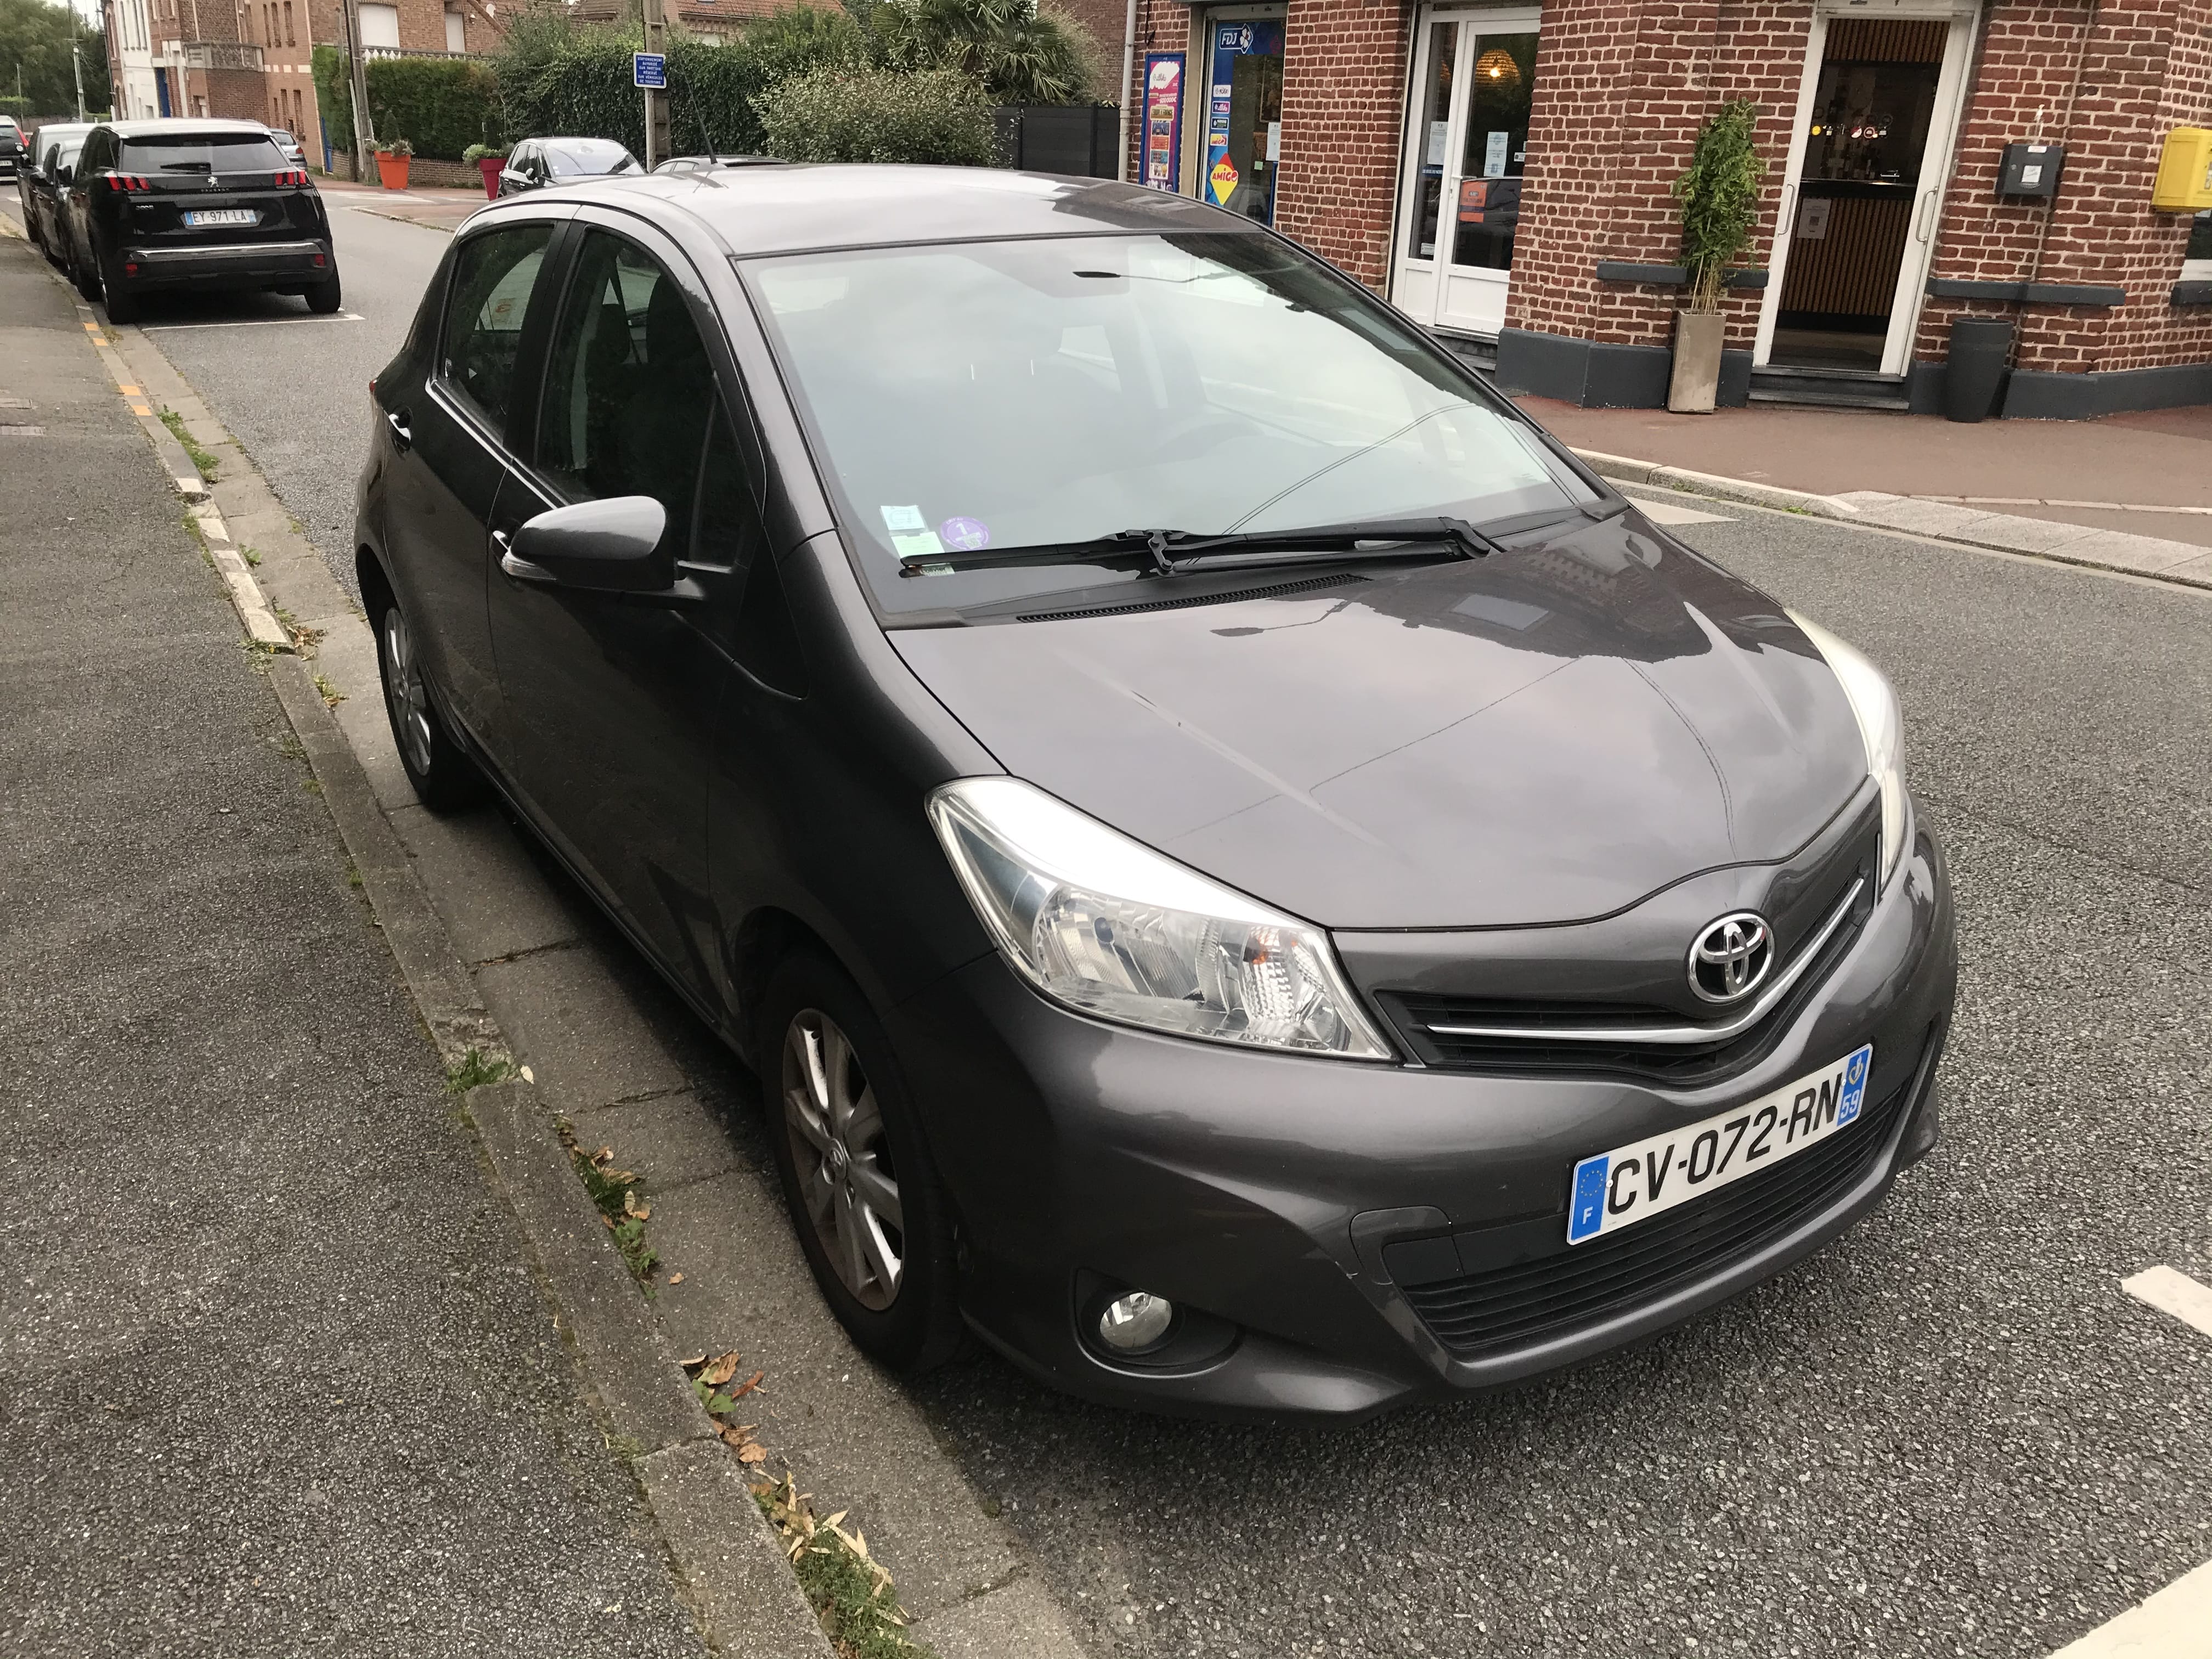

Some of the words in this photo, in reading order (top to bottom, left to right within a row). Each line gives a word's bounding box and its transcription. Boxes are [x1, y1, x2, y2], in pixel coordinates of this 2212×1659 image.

[1221, 32, 1238, 45] FDJ
[1212, 167, 1238, 182] AMIGO
[1839, 1092, 1860, 1120] 59
[1607, 1073, 1843, 1215] CV-072-RN
[1582, 1206, 1594, 1225] F
